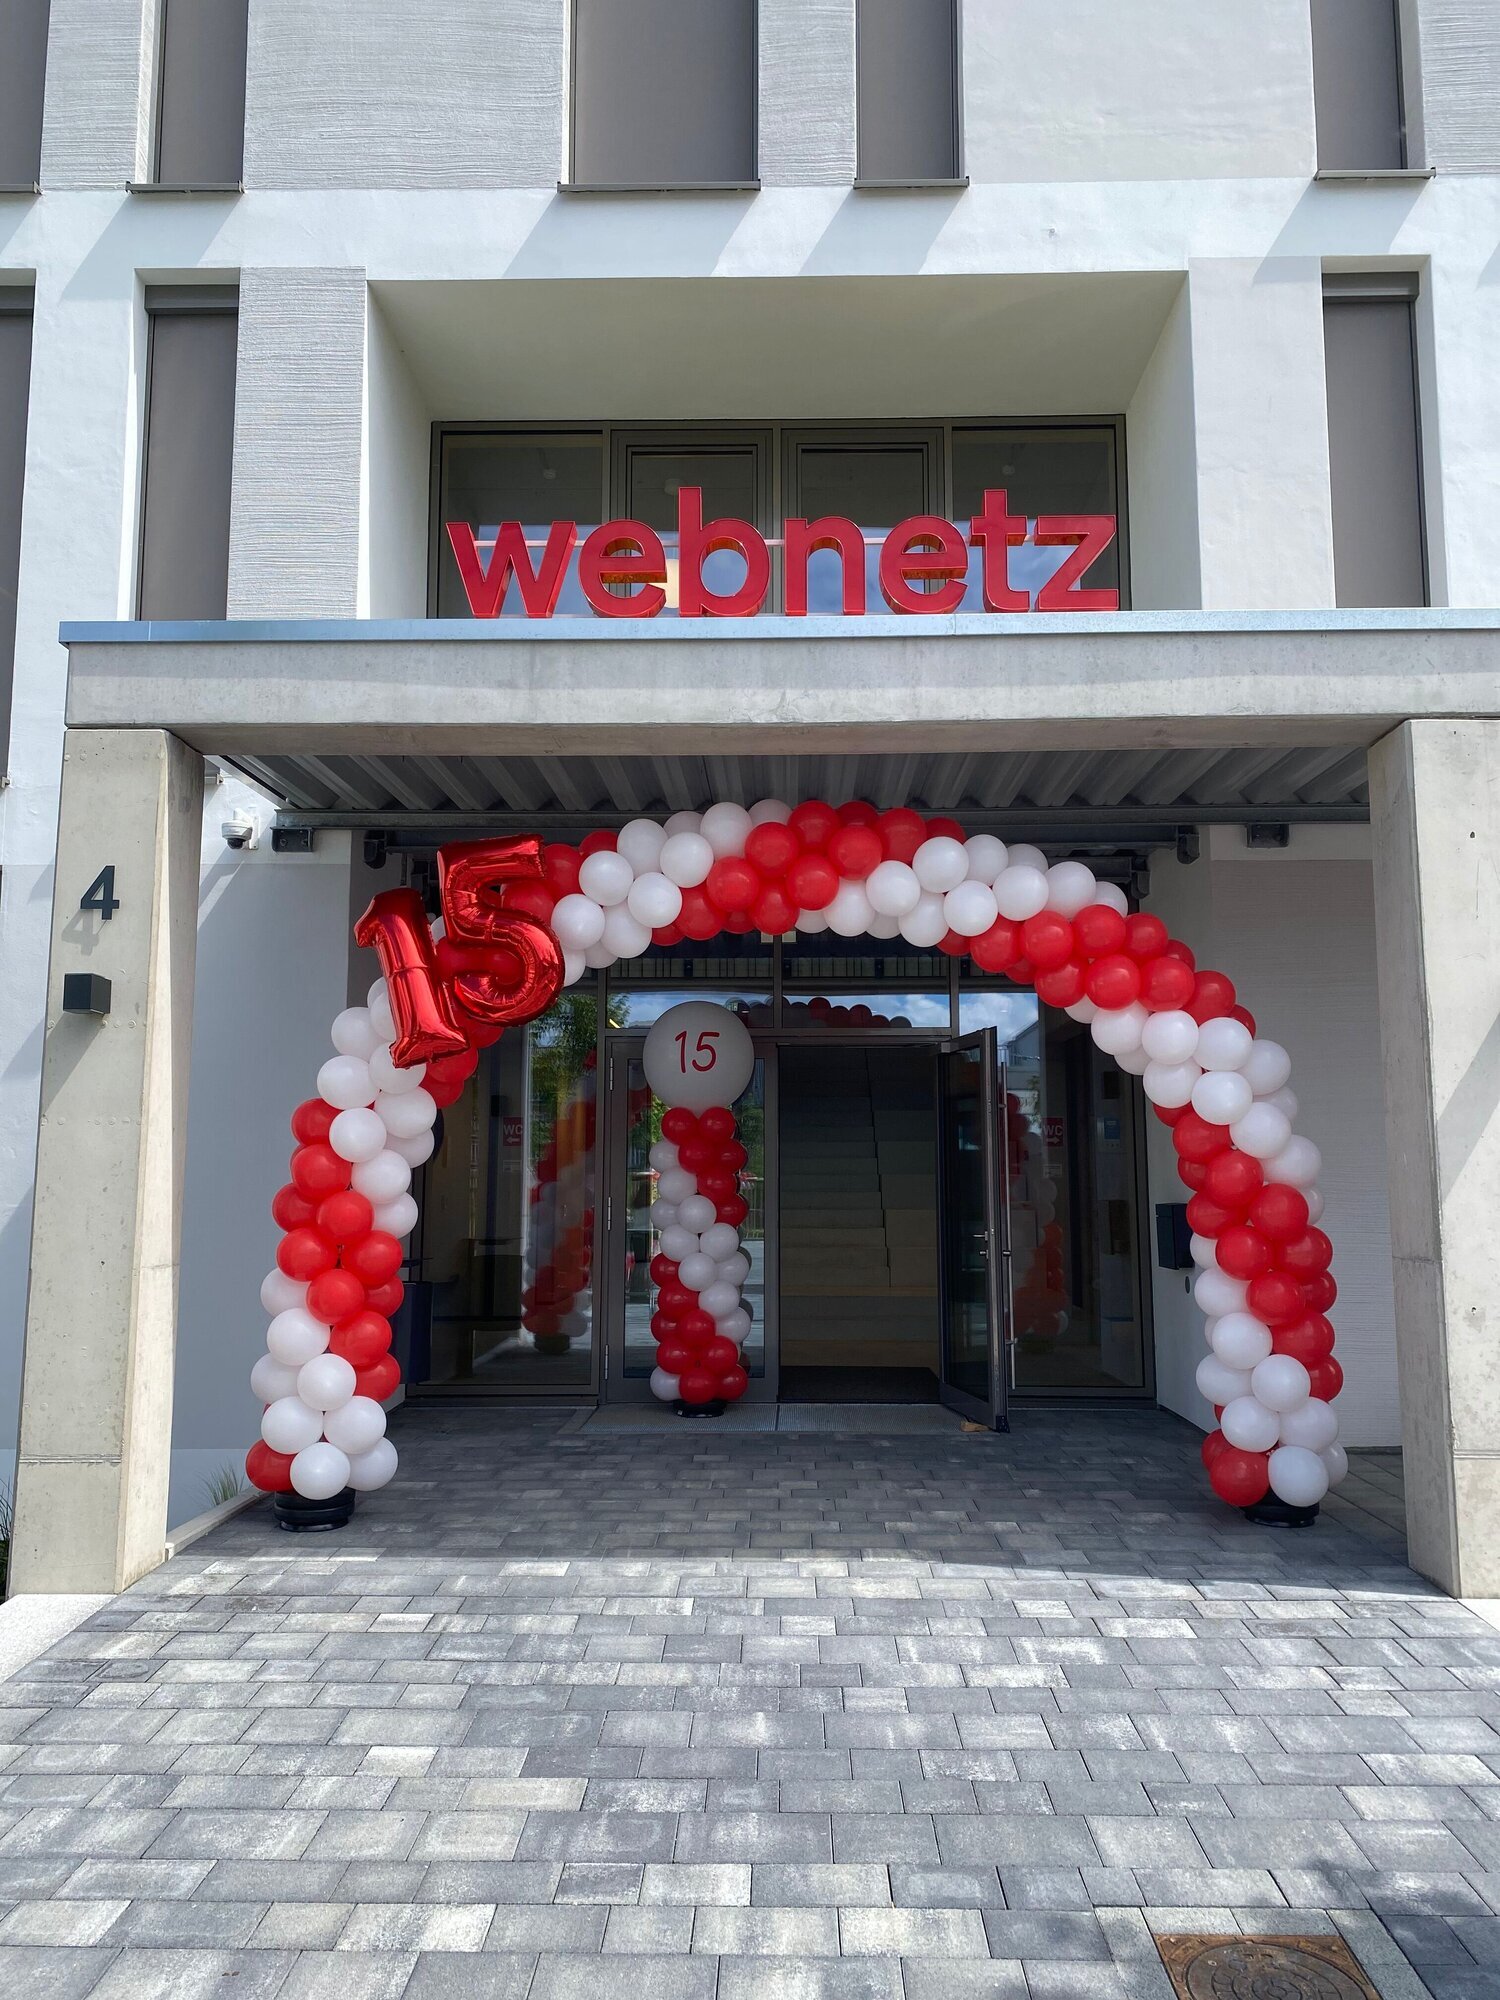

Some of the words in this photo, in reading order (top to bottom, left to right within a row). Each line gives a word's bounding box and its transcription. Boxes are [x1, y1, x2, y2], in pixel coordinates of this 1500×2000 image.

[446, 487, 1119, 618] webnetz
[80, 865, 120, 921] 4
[675, 1031, 720, 1073] 15
[503, 1124, 524, 1136] WC
[1043, 1125, 1064, 1136] WC
